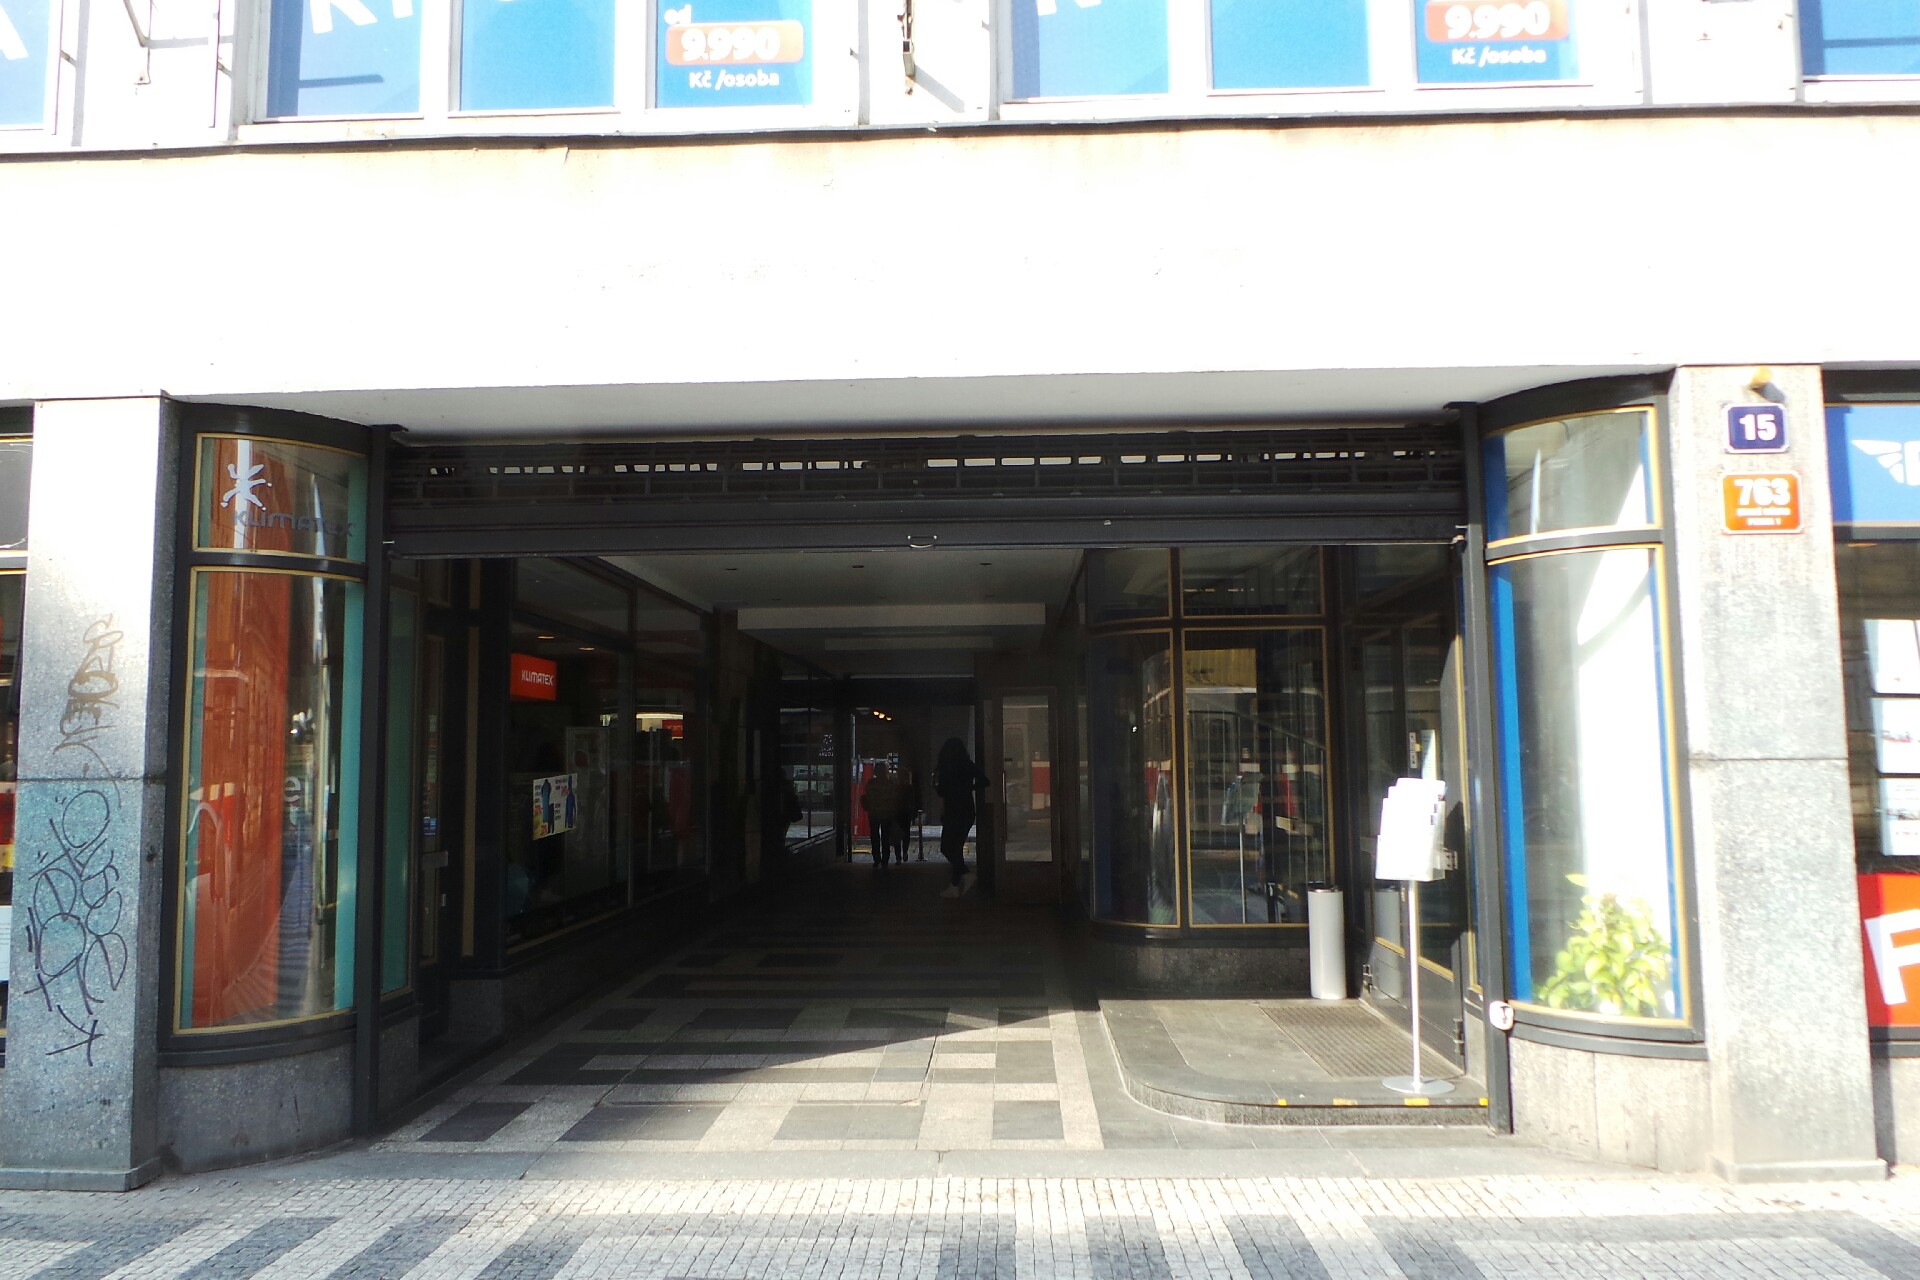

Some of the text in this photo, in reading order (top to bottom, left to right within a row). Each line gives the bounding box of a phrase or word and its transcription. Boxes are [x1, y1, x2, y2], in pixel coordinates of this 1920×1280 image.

[664, 4, 691, 25] od
[1444, 1, 1551, 40] 9.990
[681, 26, 780, 62] 9.990
[689, 70, 712, 88] Kč
[1739, 414, 1777, 441] 15
[1734, 477, 1791, 506] 763
[521, 669, 554, 686] KLIMATEX
